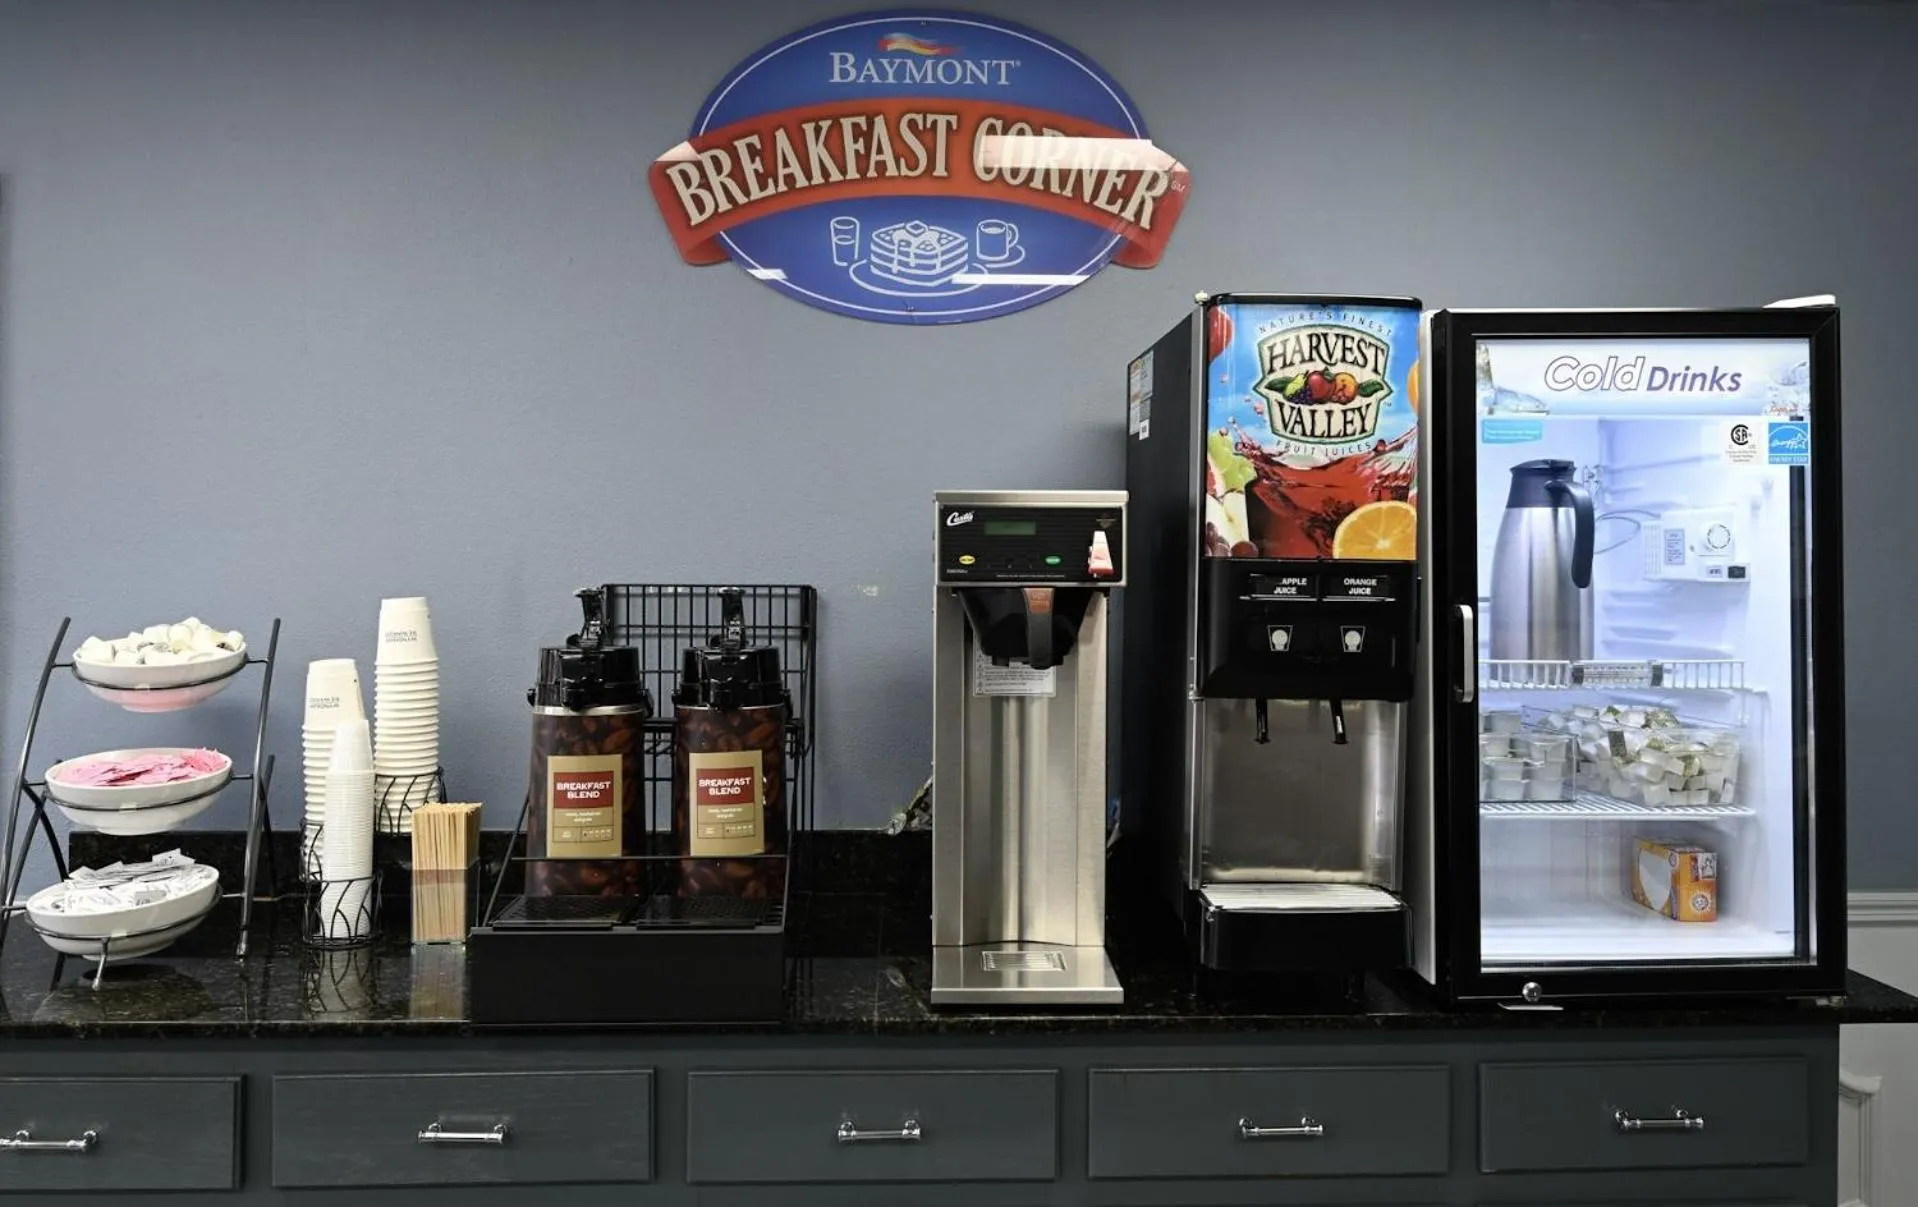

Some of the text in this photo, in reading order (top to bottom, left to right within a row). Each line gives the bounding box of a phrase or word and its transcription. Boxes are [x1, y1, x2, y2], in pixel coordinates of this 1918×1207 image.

[828, 52, 1015, 85] BAYMONT
[666, 112, 1170, 230] BREAKFAST CORNER
[1266, 332, 1386, 375] HARVEST
[1544, 355, 1743, 392] Cold Drinks
[1275, 401, 1372, 439] VALLEY
[1276, 440, 1372, 457] FRUIT JUICES
[1281, 577, 1307, 586] APPLE
[1343, 578, 1377, 586] ORANGE
[1273, 586, 1297, 595] JUICE
[1348, 587, 1372, 595] JUICE
[556, 780, 611, 791] BREAKFAST
[699, 777, 752, 787] BREAKFAST
[567, 790, 600, 799] BLEND
[709, 787, 741, 796] BLEND
